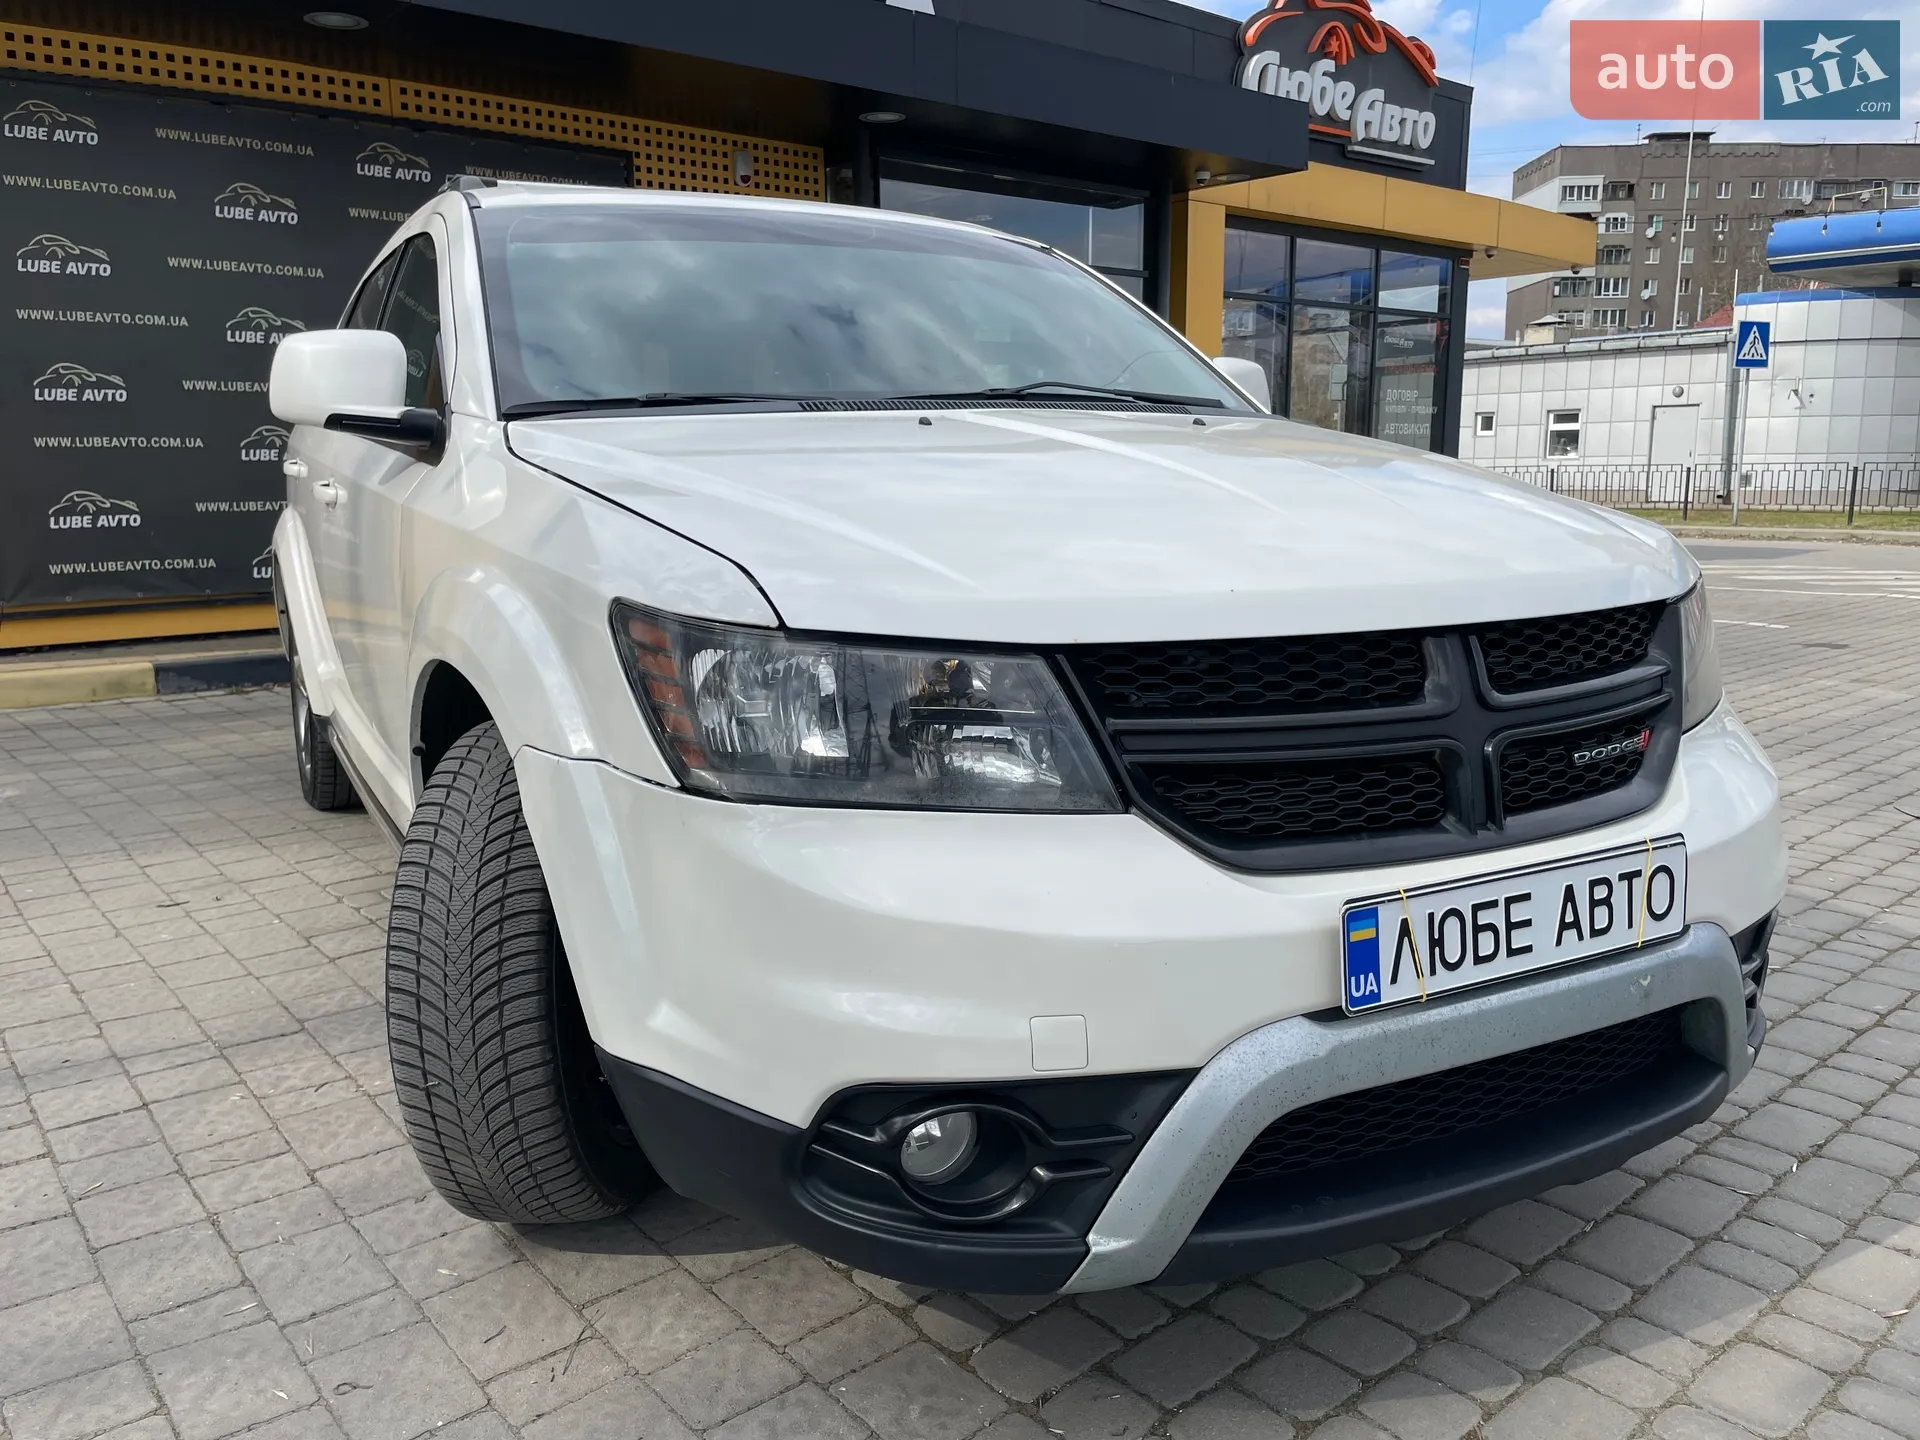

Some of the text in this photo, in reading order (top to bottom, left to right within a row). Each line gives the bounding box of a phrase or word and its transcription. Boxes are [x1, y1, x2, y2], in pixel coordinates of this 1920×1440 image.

[4, 124, 98, 145] LUBE AVTO
[155, 127, 314, 156] WWW.LUBEAVTO.COM.UA
[356, 163, 431, 183] LUBE AVTO
[3, 174, 176, 200] WWW.LUBEAVTO.COM.UA
[215, 205, 298, 225] LUBE AVTO
[17, 259, 111, 277] LUBE AVTO
[167, 257, 324, 279] WWW.LUBEAVTO.COM.UA
[16, 309, 189, 327] WWW.LUBEAVTO.COM.UA
[226, 330, 265, 344] LUBE
[34, 388, 127, 402] LUBE AVTO
[182, 380, 269, 392] WWW.LUBEAV
[1384, 423, 1430, 435] АВТОВИКУП
[34, 436, 204, 448] WWW.LUBEAVTO.COM.UA
[241, 449, 279, 461] LUBE
[50, 513, 142, 529] LUBE AVTO
[49, 557, 217, 575] WWW.LUBEAVTO.COM.UA
[253, 566, 272, 579] LU
[1574, 735, 1645, 766] DODGE
[1389, 864, 1676, 985] ЛЮБЕ АВТО
[1350, 972, 1379, 998] UA
